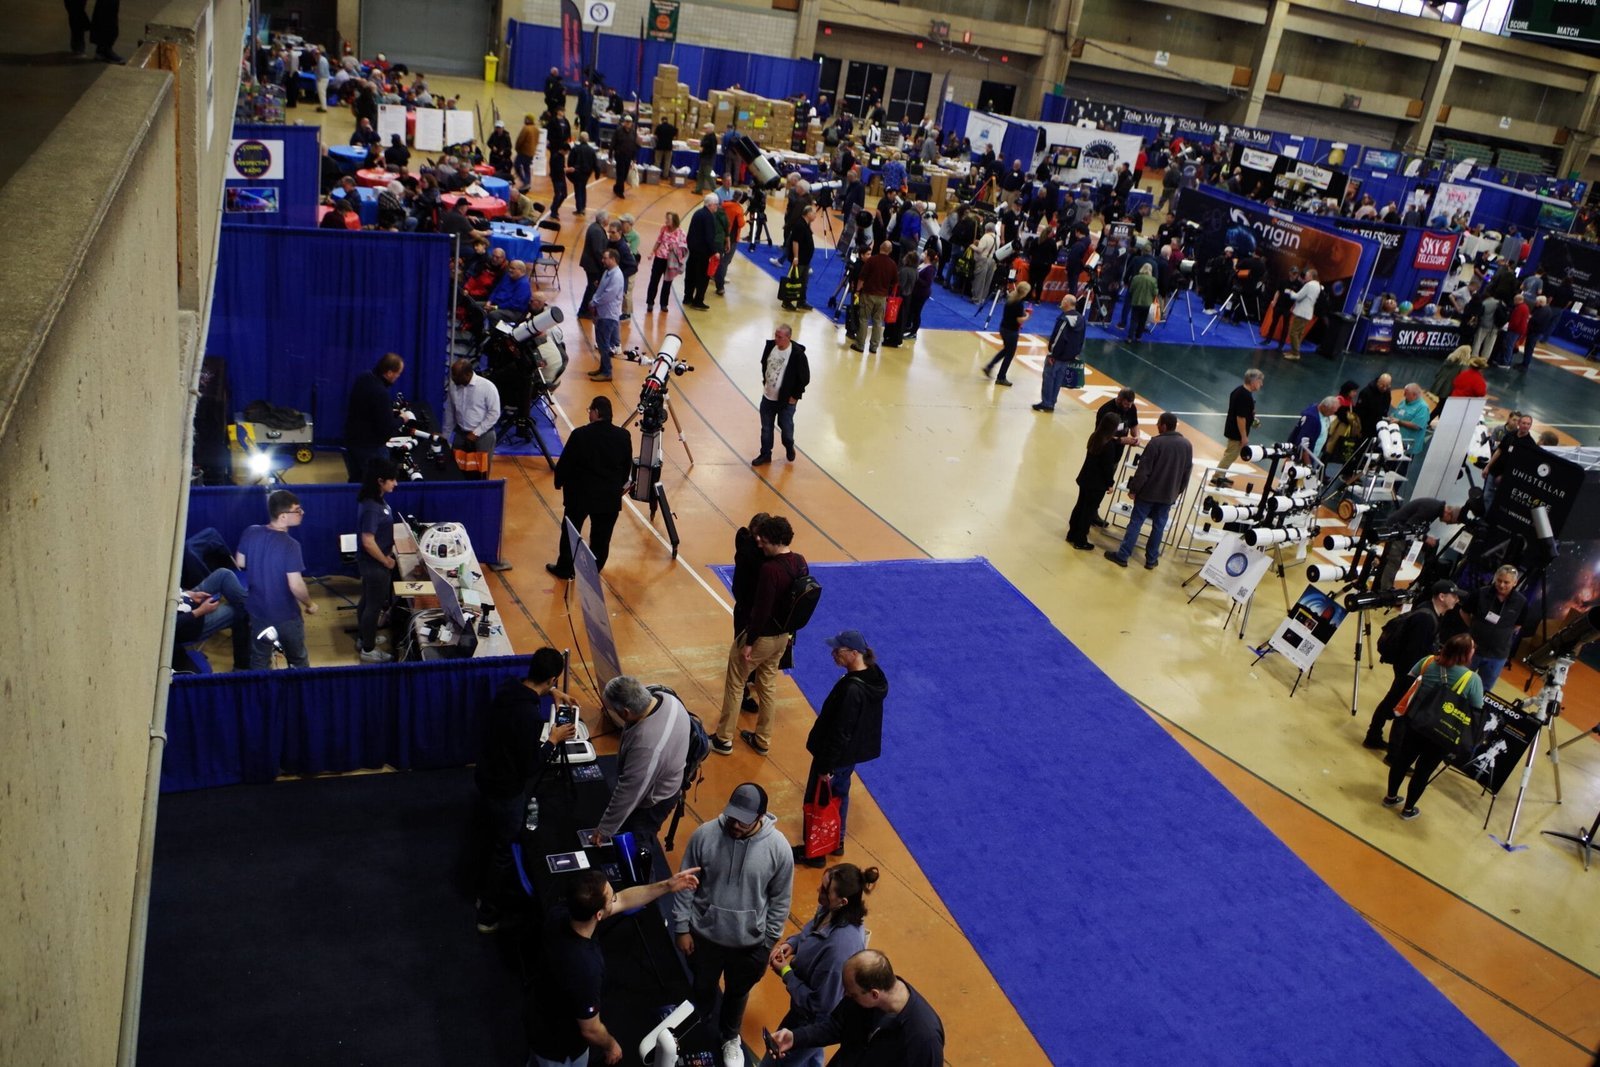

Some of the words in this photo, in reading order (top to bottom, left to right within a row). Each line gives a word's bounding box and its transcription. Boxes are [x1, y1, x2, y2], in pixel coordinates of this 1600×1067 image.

[1509, 20, 1529, 30] SCORE
[1556, 26, 1580, 37] MATCH
[1124, 110, 1142, 123] Tele
[1145, 113, 1163, 125] Vue
[1178, 118, 1197, 131] Tele
[1199, 121, 1217, 134] Vue
[1232, 127, 1250, 139] Tele
[1253, 130, 1270, 142] Vue
[1420, 237, 1440, 255] SKY
[1441, 240, 1452, 255] &
[1417, 253, 1447, 266] TELESCOPE
[1397, 330, 1418, 346] SKY
[1512, 468, 1567, 499] UNISTELLAR
